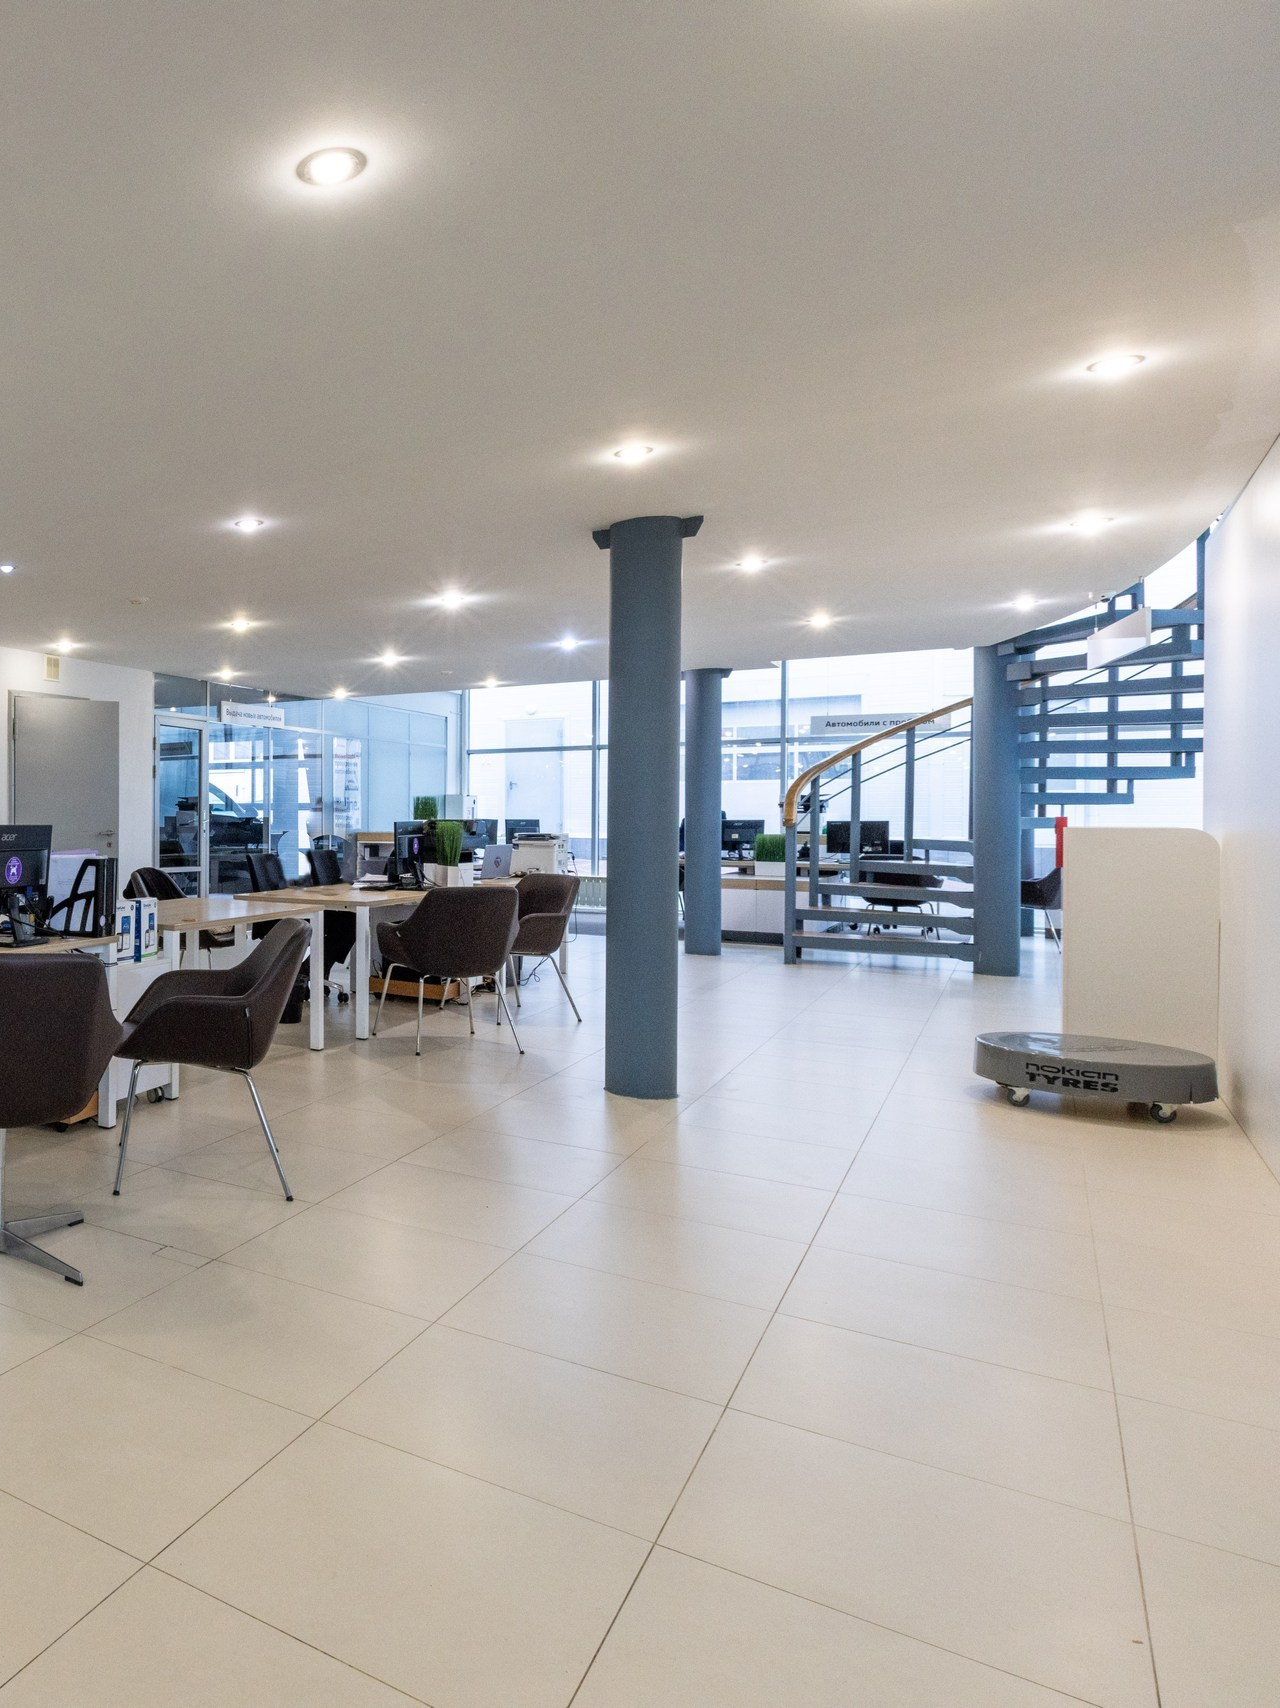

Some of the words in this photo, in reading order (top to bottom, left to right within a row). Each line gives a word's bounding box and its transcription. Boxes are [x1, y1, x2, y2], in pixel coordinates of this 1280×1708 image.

[825, 720, 880, 728] Автомобили
[1, 833, 18, 841] acer
[1025, 1062, 1119, 1081] nokian
[1025, 1071, 1119, 1093] TYRES
